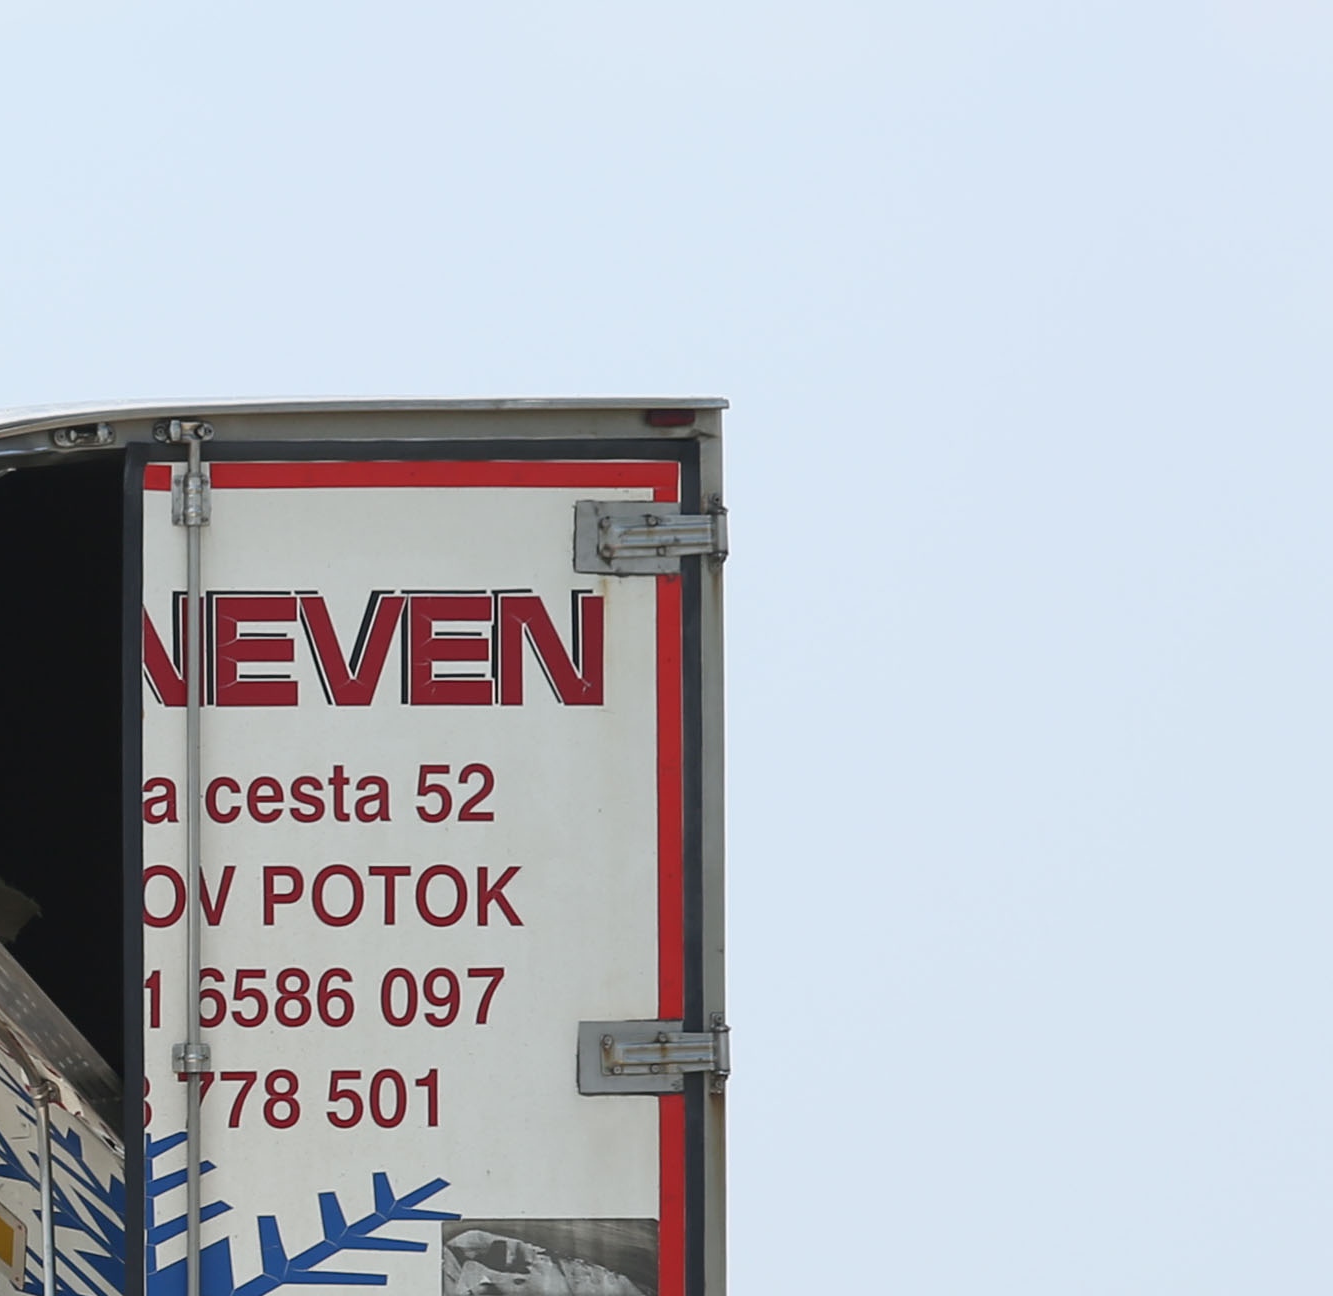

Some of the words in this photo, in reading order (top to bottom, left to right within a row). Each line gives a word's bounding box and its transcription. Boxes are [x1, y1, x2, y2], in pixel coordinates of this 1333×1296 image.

[142, 589, 604, 707] NEVEN
[204, 764, 392, 823] cesta
[417, 763, 495, 823] 52
[142, 865, 237, 928] OV
[263, 864, 524, 928] POTOK
[199, 967, 356, 1029] 6586
[380, 967, 506, 1028] 097
[177, 1069, 302, 1130] 778
[326, 1069, 440, 1129] 501
